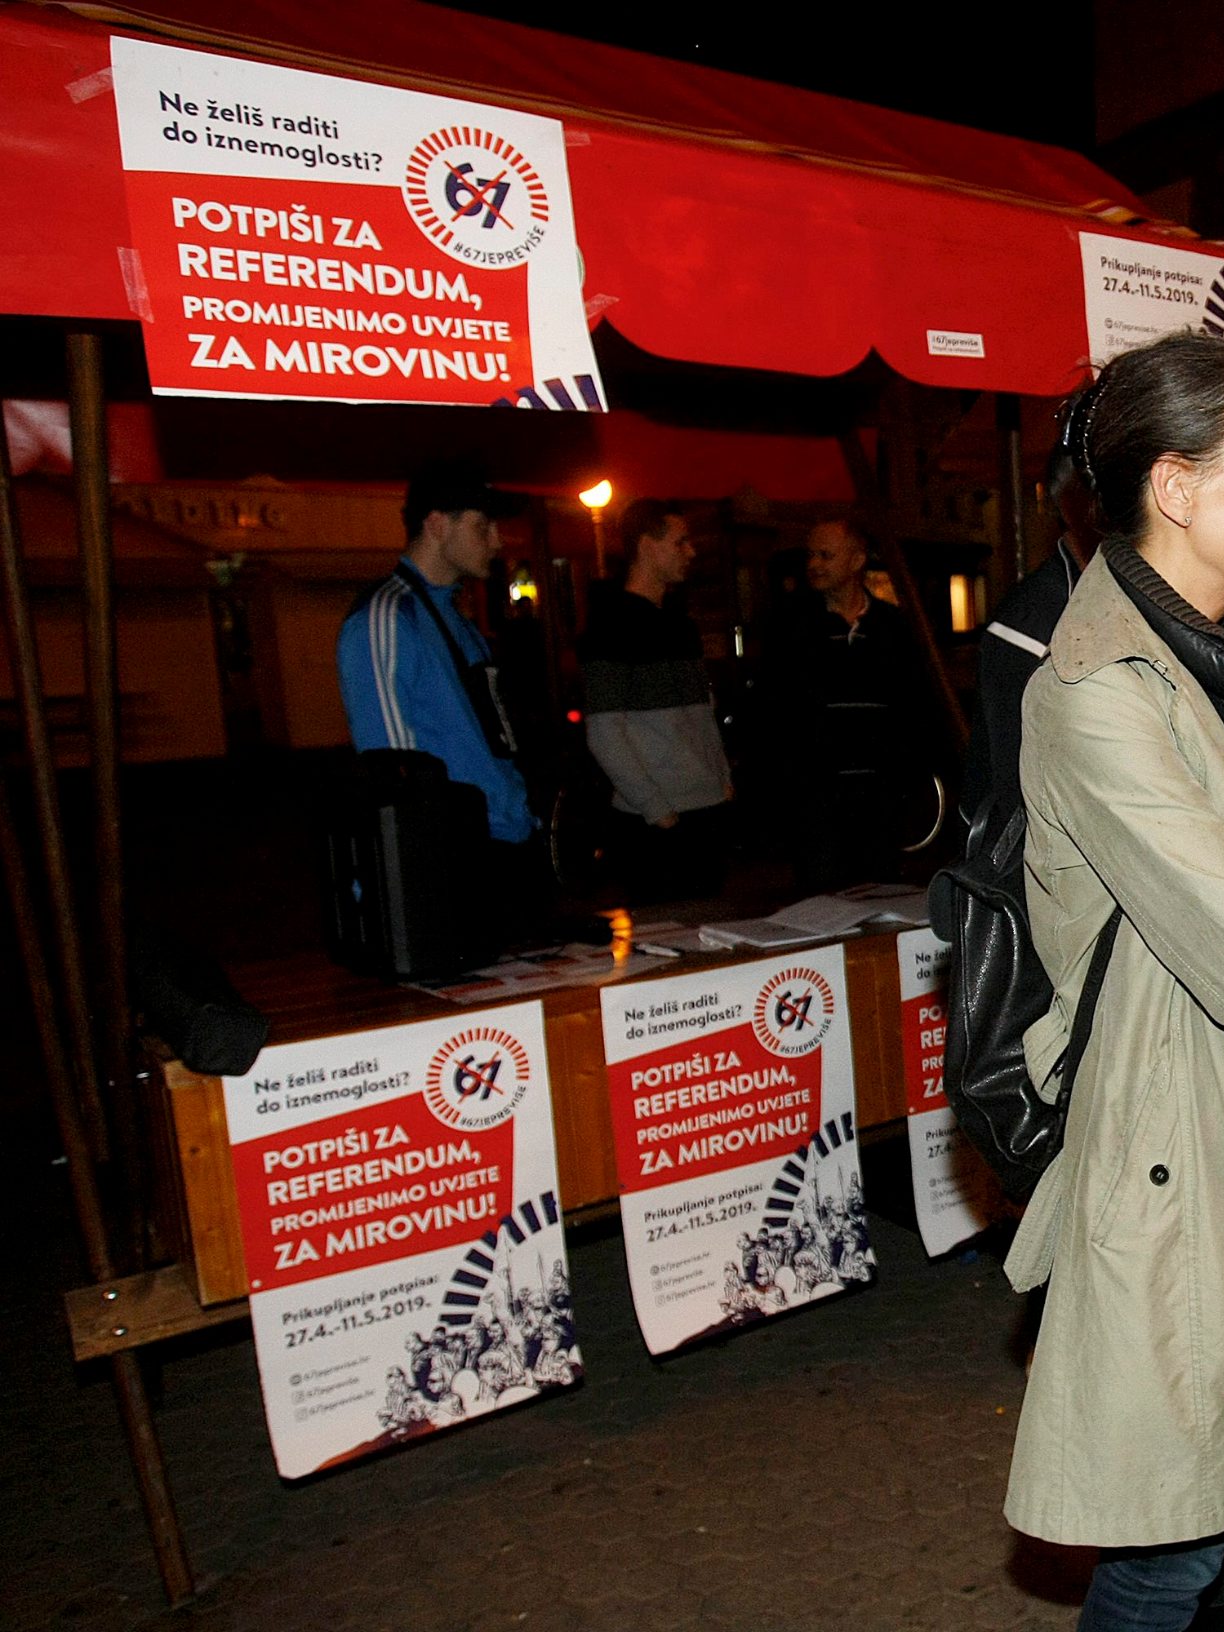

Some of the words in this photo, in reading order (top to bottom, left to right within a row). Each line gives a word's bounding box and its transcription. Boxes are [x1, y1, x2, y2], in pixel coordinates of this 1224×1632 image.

[158, 90, 199, 117] Ne
[206, 99, 264, 128] želiš
[272, 113, 340, 140] raditi
[162, 122, 198, 146] do
[205, 127, 384, 173] iznemoglosti?
[444, 162, 511, 230] 67
[171, 197, 324, 246] POTPIŠI
[331, 221, 383, 251] ZA
[453, 223, 546, 266] #67JEPREVIŠE
[176, 242, 483, 311] REFERENDUM,
[1100, 256, 1162, 280] Prikupljanje
[1164, 270, 1204, 286] potpisa:
[1103, 276, 1199, 306] 27.4.-11.5.2019.
[182, 295, 408, 337] PROMIJENIMO
[411, 314, 512, 343] UVJETE
[187, 332, 256, 373] ZA
[263, 338, 512, 382] MIROVINU!
[915, 951, 931, 965] Ne
[917, 967, 931, 981] do
[624, 1009, 645, 1023] Ne
[648, 1001, 679, 1019] želiš
[682, 992, 719, 1011] raditi
[626, 1026, 645, 1040] do
[648, 1004, 743, 1035] iznemoglosti?
[253, 1077, 282, 1095] Ne
[285, 1067, 327, 1090] želiš
[330, 1058, 379, 1082] raditi
[256, 1097, 282, 1115] do
[285, 1071, 411, 1108] iznemoglosti?
[631, 1053, 711, 1091] POTPIŠI
[714, 1051, 741, 1071] ZA
[634, 1065, 796, 1119] REFERENDUM,
[637, 1101, 755, 1145] PROMIJENIMO
[757, 1089, 811, 1115] UVJETE
[262, 1127, 369, 1174] POTPIŠI
[374, 1124, 410, 1150] ZA
[639, 1149, 674, 1175] ZA
[678, 1112, 809, 1166] MIROVINU!
[267, 1139, 482, 1206] REFERENDUM,
[270, 1184, 426, 1235] PROMIJENIMO
[430, 1166, 500, 1197] UVJETE
[644, 1196, 716, 1223] Prikupljanje
[718, 1182, 763, 1204] potpisa:
[646, 1201, 758, 1243] 27.4.-11.5.2019.
[273, 1237, 320, 1271] ZA
[325, 1192, 498, 1257] MIROVINU!
[281, 1289, 375, 1327] Prikupljanje
[379, 1272, 439, 1300] potpisa:
[284, 1294, 432, 1348] 27.4.-11.5.2019.
